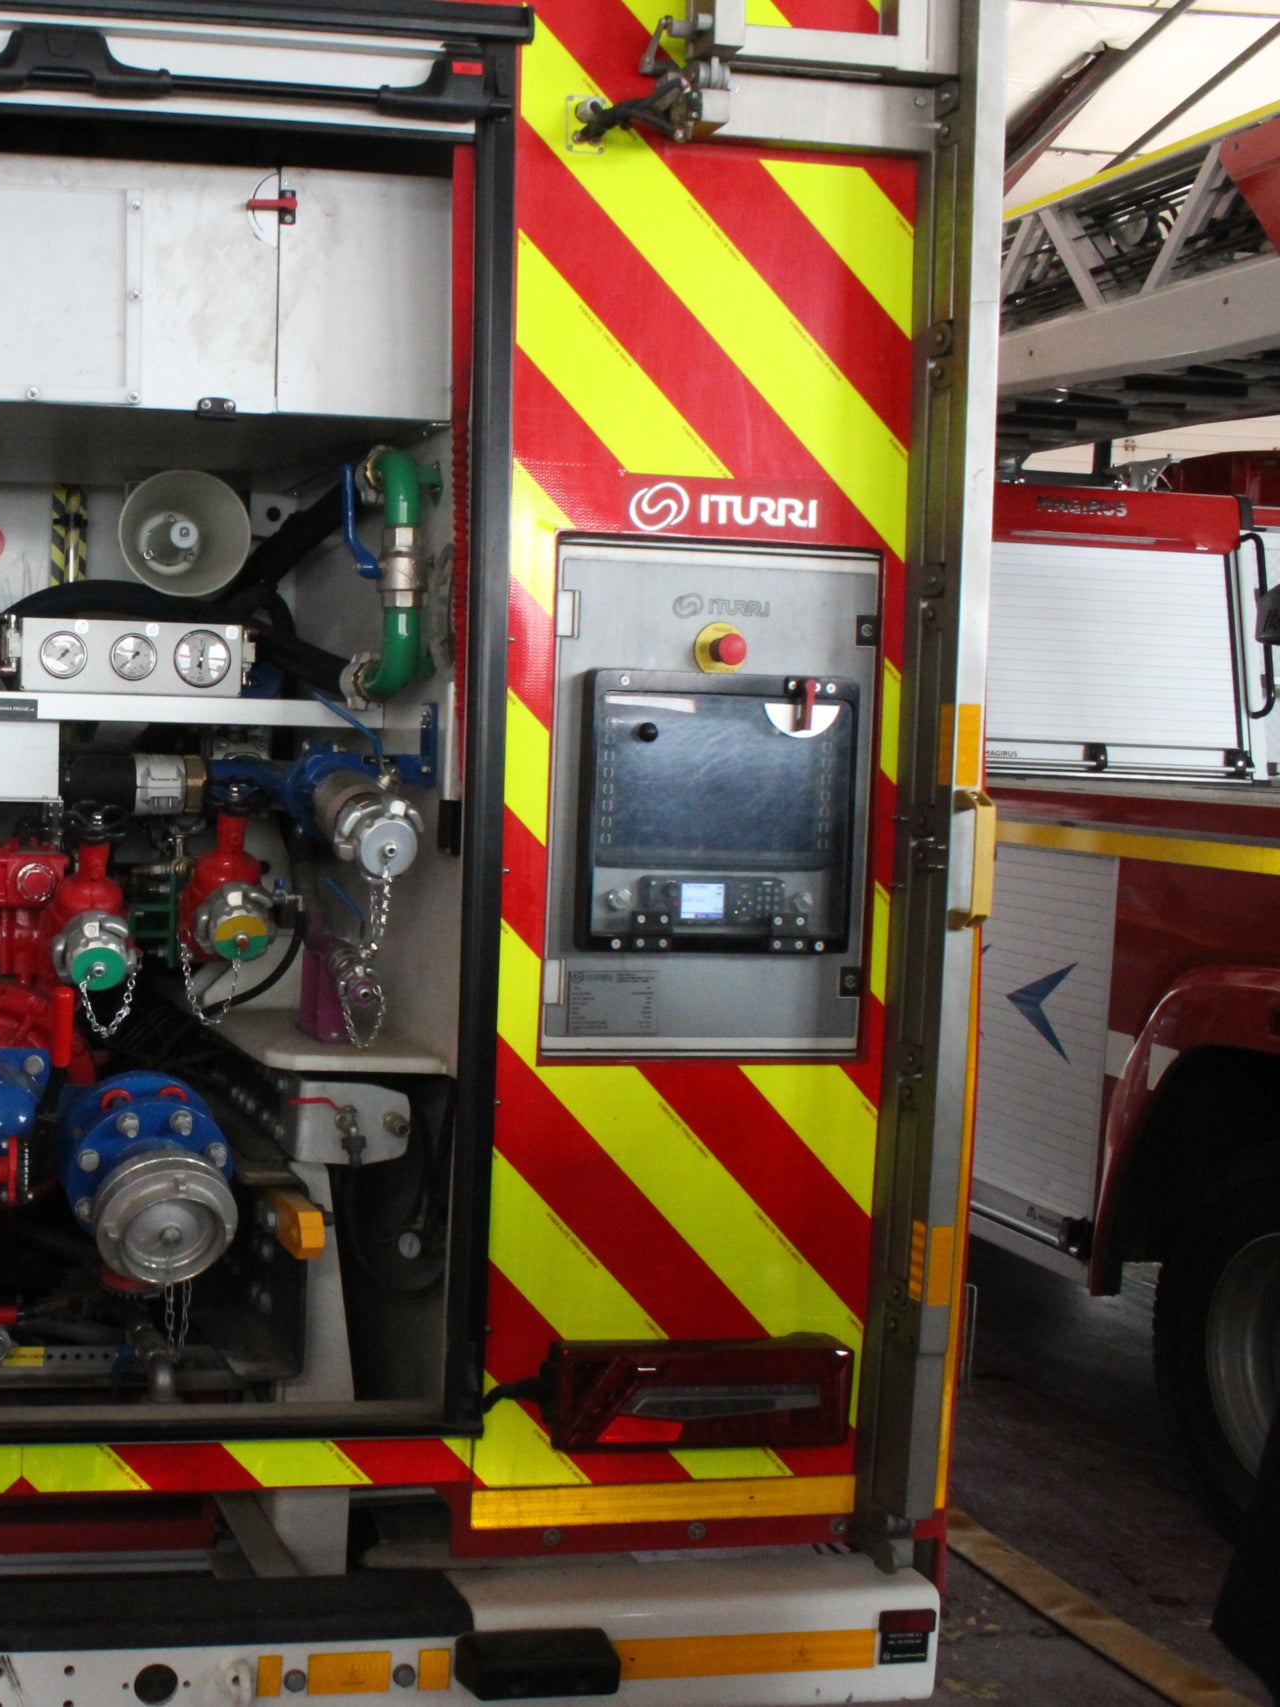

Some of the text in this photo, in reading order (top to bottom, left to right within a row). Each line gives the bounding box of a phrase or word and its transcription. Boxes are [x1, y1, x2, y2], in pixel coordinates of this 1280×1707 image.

[700, 494, 818, 528] ITURRI
[1036, 495, 1128, 518] MAGIRUS
[708, 598, 770, 618] ITURRI
